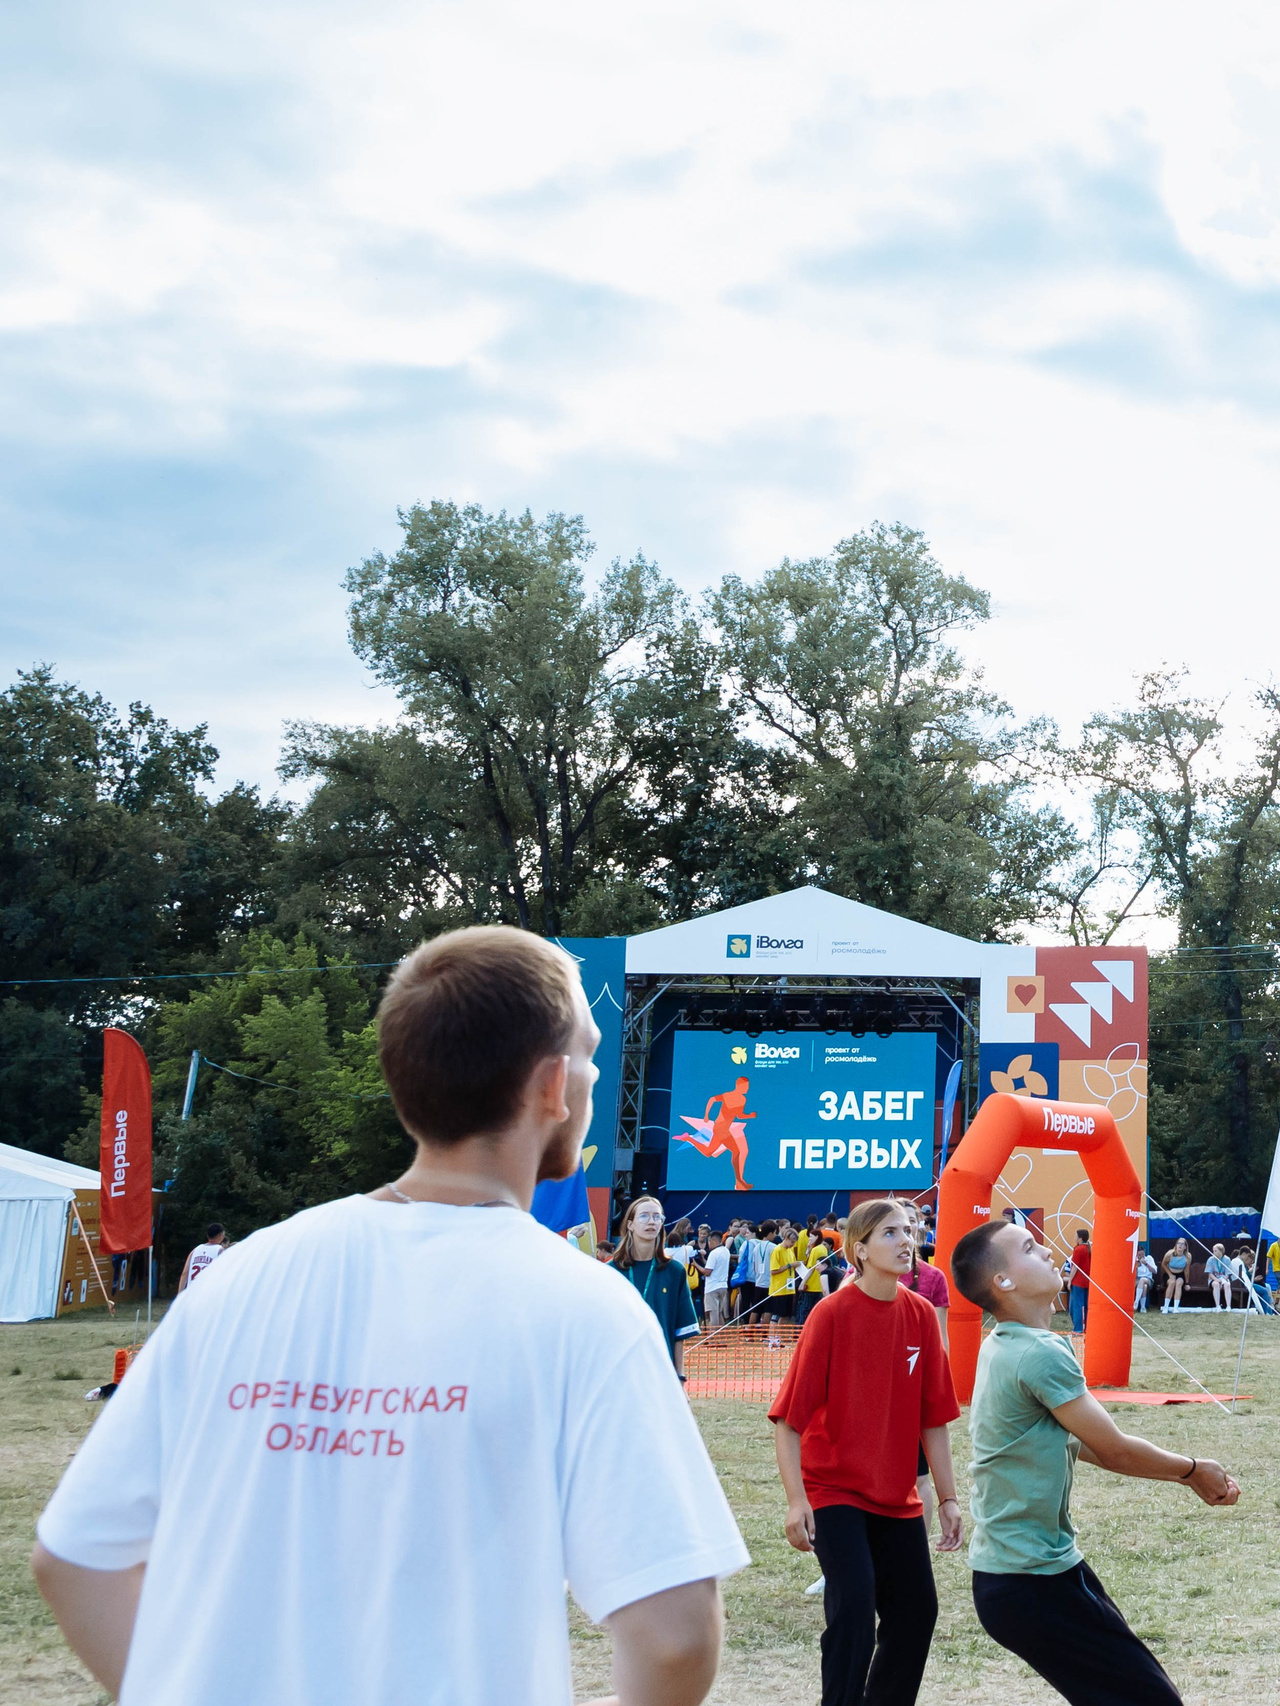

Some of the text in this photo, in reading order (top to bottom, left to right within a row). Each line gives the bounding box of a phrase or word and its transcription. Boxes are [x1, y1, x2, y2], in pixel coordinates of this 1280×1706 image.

[756, 935, 804, 949] iВолга
[755, 1043, 800, 1059] iВолга
[825, 1047, 850, 1055] проект
[818, 1090, 924, 1121] ЗАБЕГ
[1042, 1106, 1095, 1139] Первые
[110, 1110, 131, 1198] Первые
[778, 1138, 923, 1169] ПЕРВЫХ
[228, 1380, 469, 1415] ОРЕНБУРГСКАЯ
[266, 1423, 405, 1457] ОБЛАСТЬ
